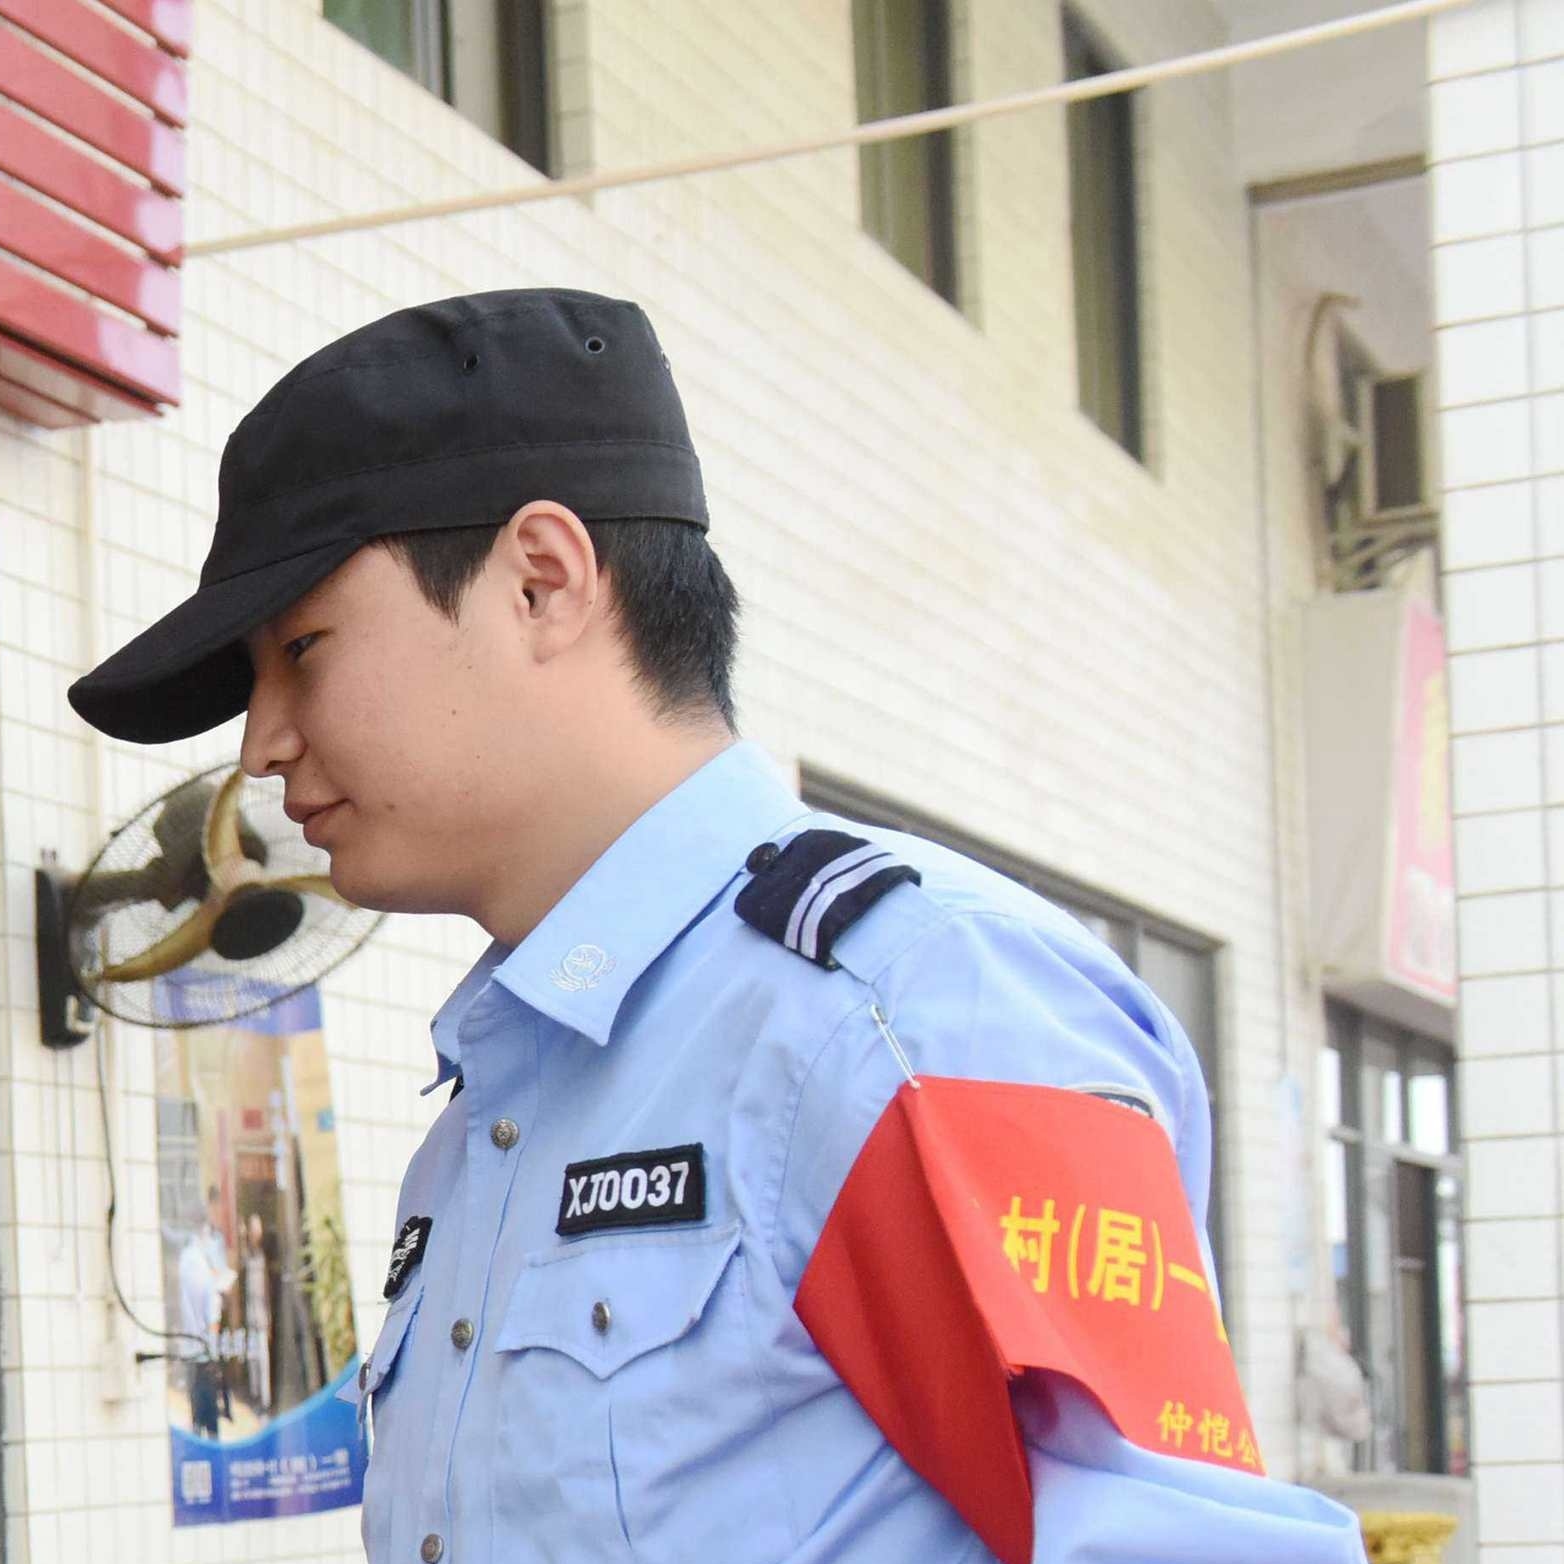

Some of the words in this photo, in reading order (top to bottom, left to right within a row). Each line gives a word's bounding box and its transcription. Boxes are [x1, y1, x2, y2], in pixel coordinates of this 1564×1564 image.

[565, 1161, 690, 1219] XJ0037
[999, 1196, 1228, 1343] 村(居)一
